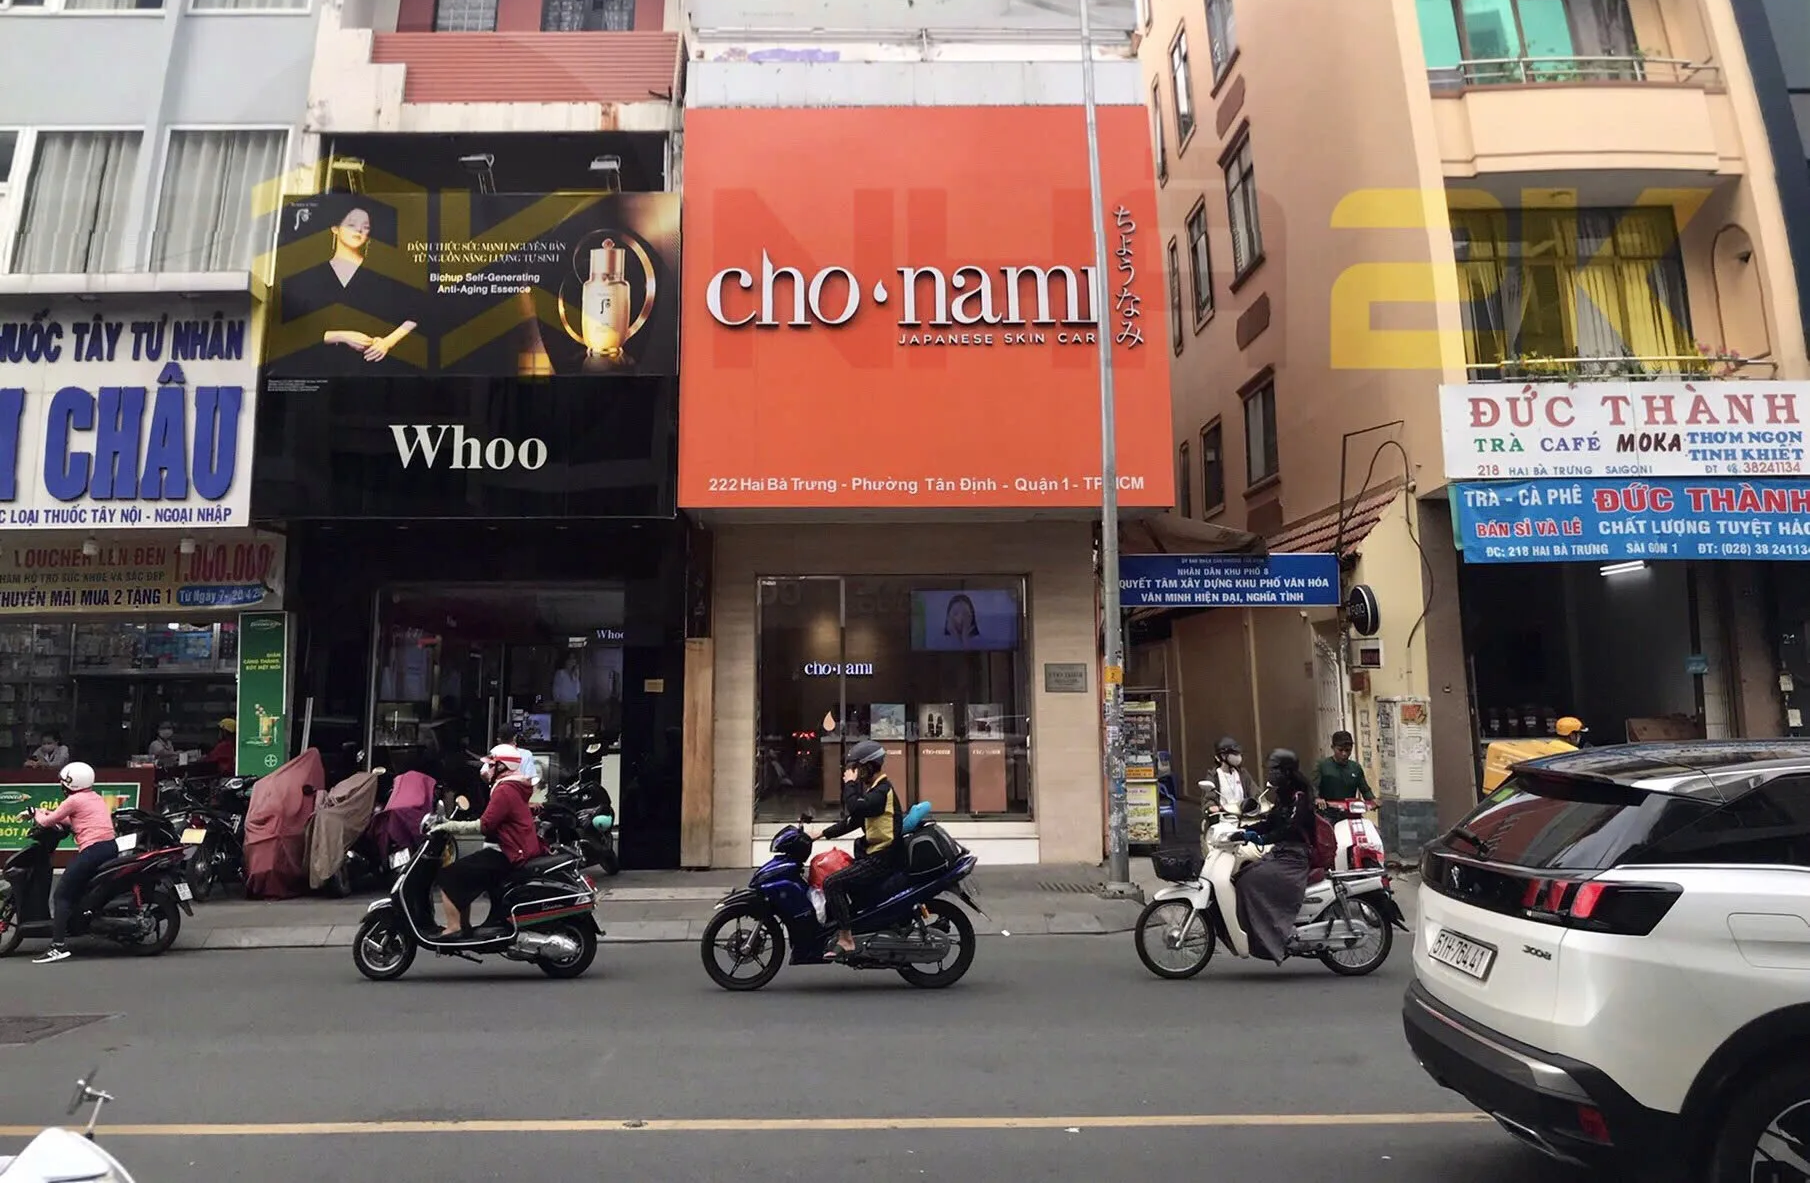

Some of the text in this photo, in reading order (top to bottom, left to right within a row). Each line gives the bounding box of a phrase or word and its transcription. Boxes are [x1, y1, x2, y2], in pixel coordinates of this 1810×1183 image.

[430, 272, 541, 284] Bichup Self-Generating
[706, 247, 861, 326] cho
[1113, 205, 1144, 349] ちょうなみ
[437, 284, 531, 295] Anti-Aging Essence
[72, 313, 123, 362] TÂY
[131, 312, 169, 362] TƯ
[171, 309, 245, 361] NHÂN
[898, 332, 1096, 345] JAPANESE SKIN CAR
[1467, 383, 1801, 429] ĐỨC THÀNH
[44, 361, 243, 502] CHÂU
[1686, 430, 1744, 444] THƠM
[388, 424, 549, 471] Whoo
[1473, 430, 1682, 453] TRÀ CAFÉ MOKA
[1477, 464, 1500, 476] 218
[1509, 466, 1529, 476] HAI
[1533, 463, 1548, 476] BÀ
[1553, 465, 1593, 476] TRƯNG
[1743, 462, 1801, 474] 38241134
[708, 477, 738, 492] 222
[740, 477, 765, 491] Hai
[767, 477, 788, 491] Bà
[791, 477, 838, 493] Trưng
[851, 476, 919, 495] Phường
[925, 477, 956, 491] Tân
[960, 477, 997, 495] Định
[1015, 477, 1059, 495] Quận
[1463, 481, 1810, 515] TRÀ CÀ PHÊ ĐỨC THÀNH
[11, 509, 39, 526] LOẠI
[43, 503, 88, 524] THUỐC
[91, 506, 117, 523] TÂY
[120, 505, 143, 526] NỘI
[154, 508, 193, 526] NGOẠI
[197, 505, 232, 526] NHẬP
[1476, 518, 1511, 538] BÁN
[1536, 517, 1559, 536] VÀ
[1598, 515, 1647, 535] CHẤT
[1651, 519, 1711, 537] LƯỢNG
[1716, 517, 1773, 538] TUYỆT
[1486, 545, 1505, 558] ĐC:
[1508, 545, 1529, 557] 218
[1532, 545, 1550, 557] HAI
[1553, 543, 1568, 556] BÀ
[1571, 543, 1609, 556] TRƯNG
[1626, 540, 1645, 554] SÀI
[1698, 542, 1718, 554] ĐT:
[1721, 542, 1751, 555] (028)
[1754, 543, 1769, 555] 38
[1224, 568, 1241, 576] KHU
[1119, 575, 1330, 590] QUYẾT TÂM XÂY DỰNG KHU PHỐ VĂN HÓA
[80, 588, 110, 606] MUA
[113, 588, 122, 605] 2
[126, 586, 161, 609] TẶNG
[166, 588, 172, 604] 1
[1165, 593, 1192, 602] MINH
[1194, 590, 1219, 603] HIỆN
[1222, 592, 1243, 603] ĐẠI,
[1246, 590, 1277, 602] NGHĨA
[1279, 590, 1304, 602] TÌNH
[804, 661, 832, 675] cho
[1522, 944, 1552, 961] 3008
